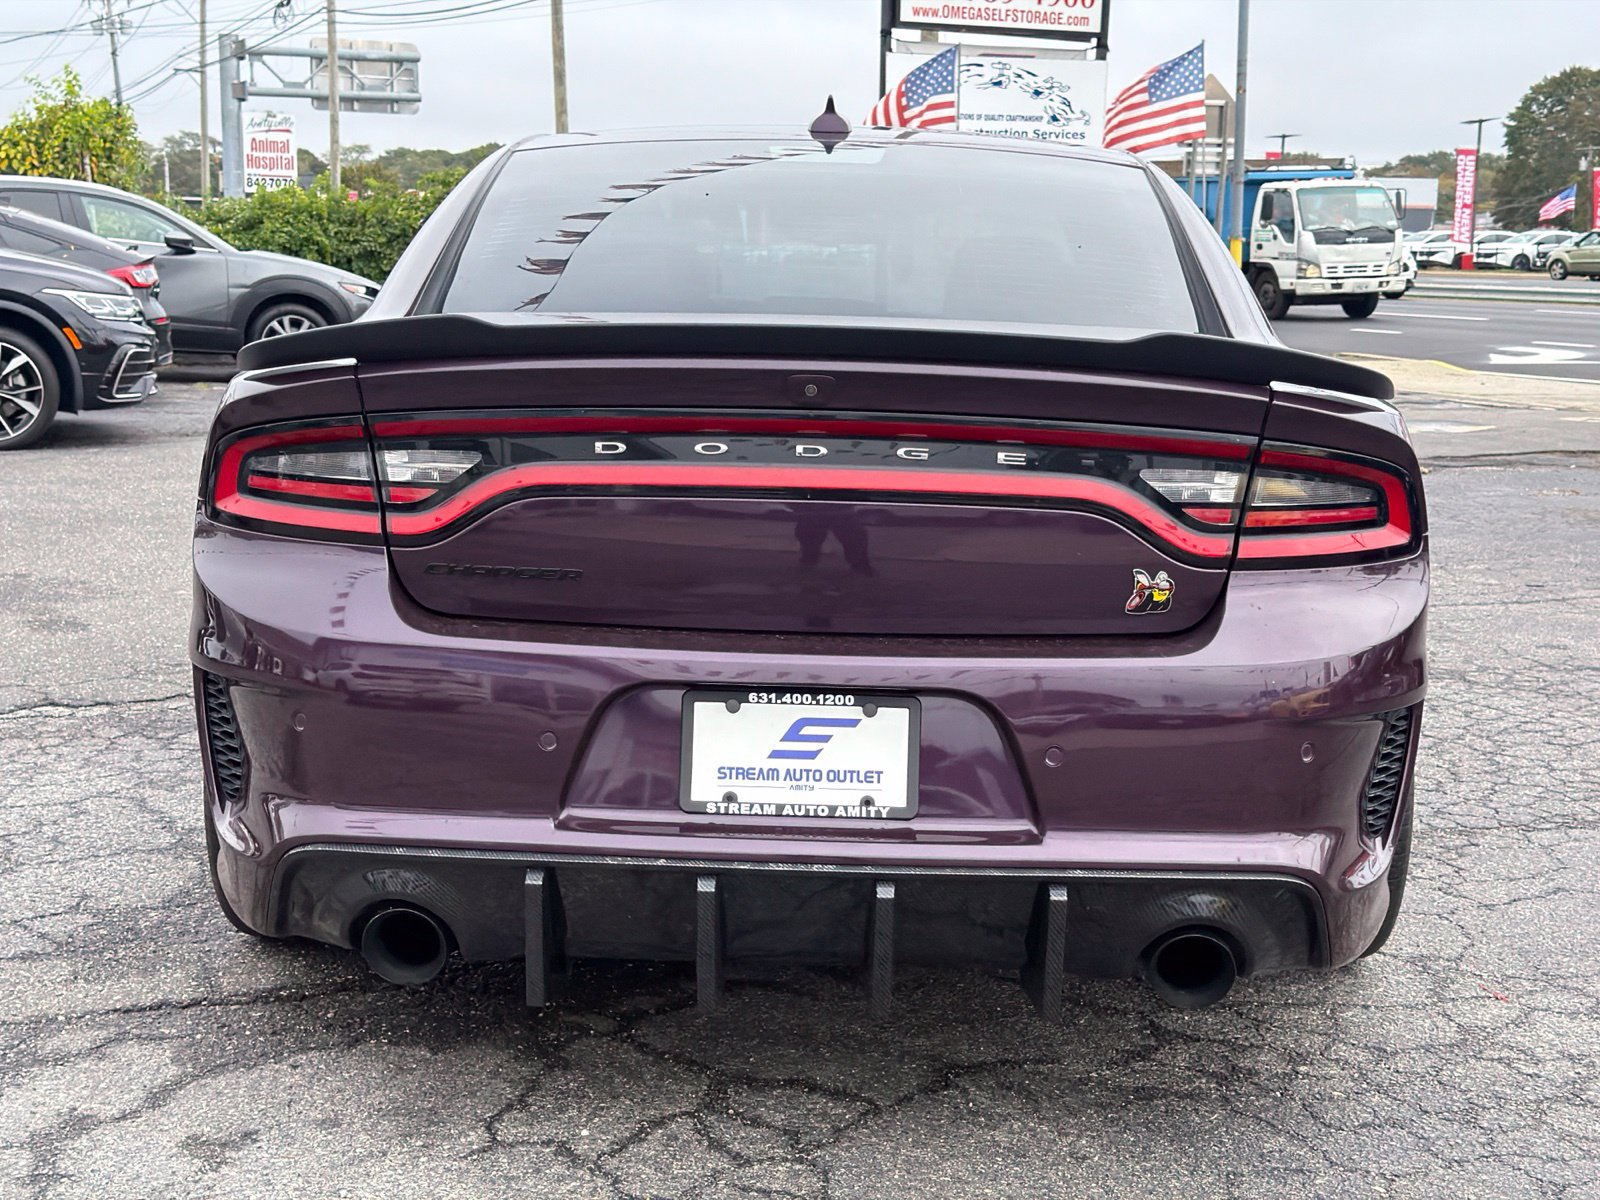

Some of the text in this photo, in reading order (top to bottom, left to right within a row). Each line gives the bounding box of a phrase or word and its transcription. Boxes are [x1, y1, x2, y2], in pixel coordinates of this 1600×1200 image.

[911, 5, 1090, 27] www.OMEGASELFSTORAGE.com
[1033, 129, 1086, 140] Services
[250, 137, 290, 154] Animal
[246, 154, 294, 171] Hospital
[1460, 154, 1477, 243] UNDER NEW
[594, 441, 1027, 466] DODGE
[424, 562, 584, 581] CHARGER
[748, 692, 855, 706] 631.400.1200
[717, 766, 884, 784] STREAM AUTO OUTLET
[705, 802, 891, 818] STREAM AUTO AMITY
